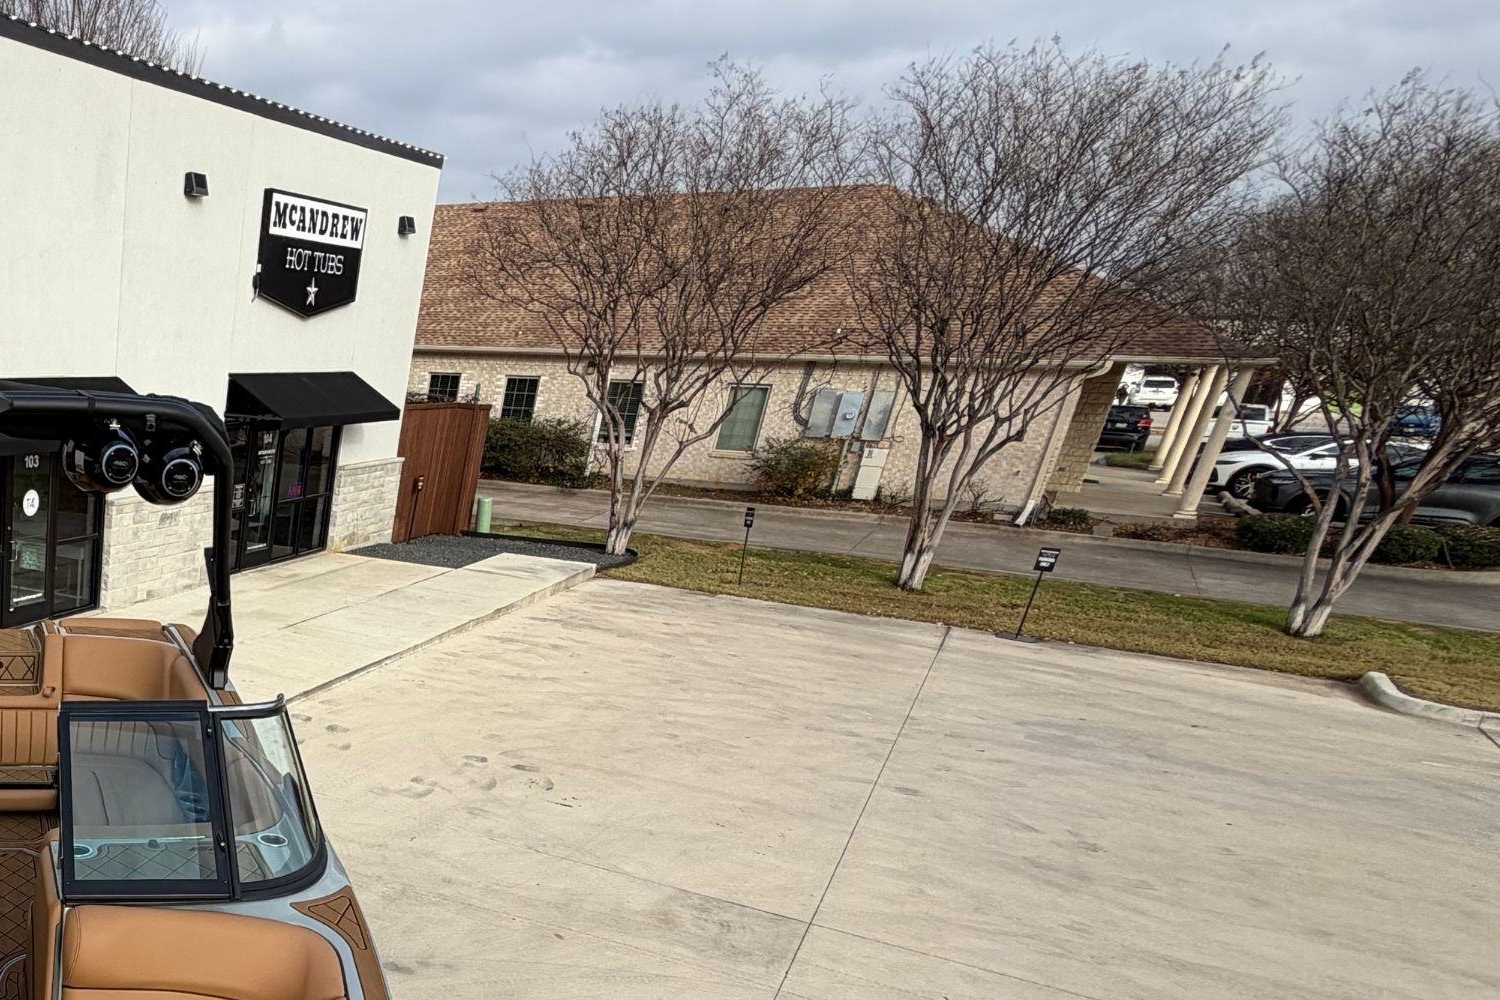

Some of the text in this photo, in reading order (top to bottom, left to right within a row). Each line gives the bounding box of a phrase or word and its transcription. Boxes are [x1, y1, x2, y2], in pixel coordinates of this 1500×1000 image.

[286, 248, 344, 275] HOT TUBS
[24, 454, 40, 468] 103
